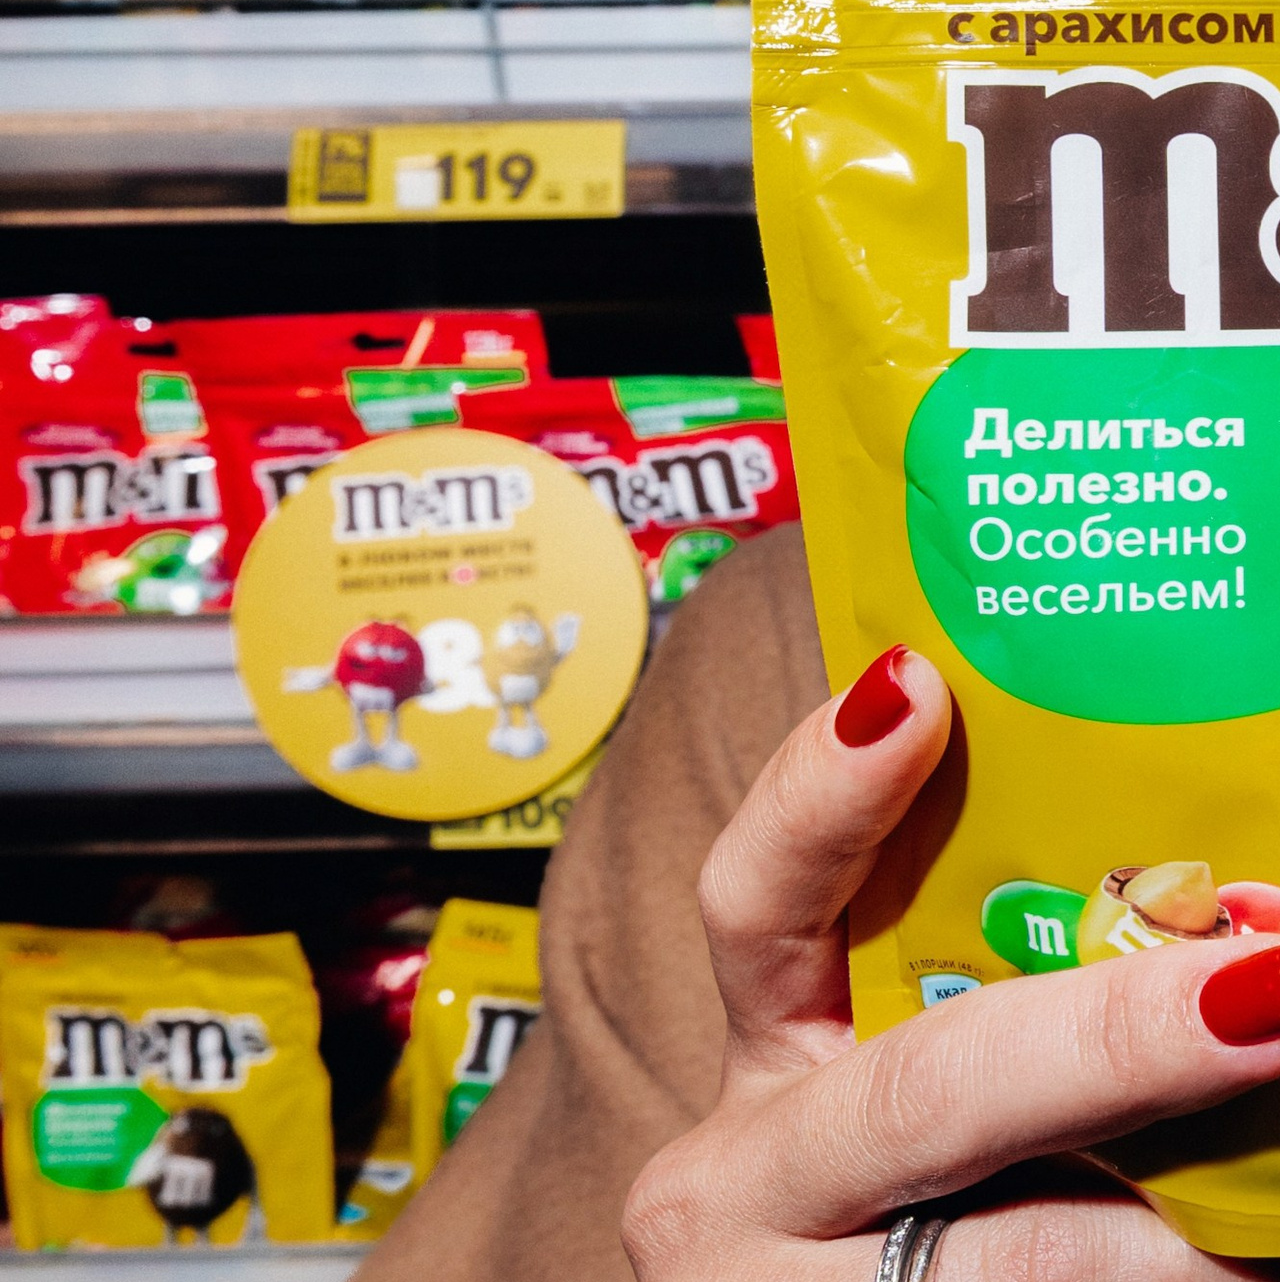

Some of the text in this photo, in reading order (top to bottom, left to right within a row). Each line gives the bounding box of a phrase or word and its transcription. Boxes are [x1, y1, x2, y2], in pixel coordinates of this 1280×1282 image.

[947, 12, 1275, 56] с арахисом
[963, 407, 1246, 459] Делиться
[967, 469, 1228, 505] полезно.
[969, 512, 1247, 562] Особенно
[975, 565, 1247, 616] весельем!
[919, 958, 957, 970] ПОРЦИИ
